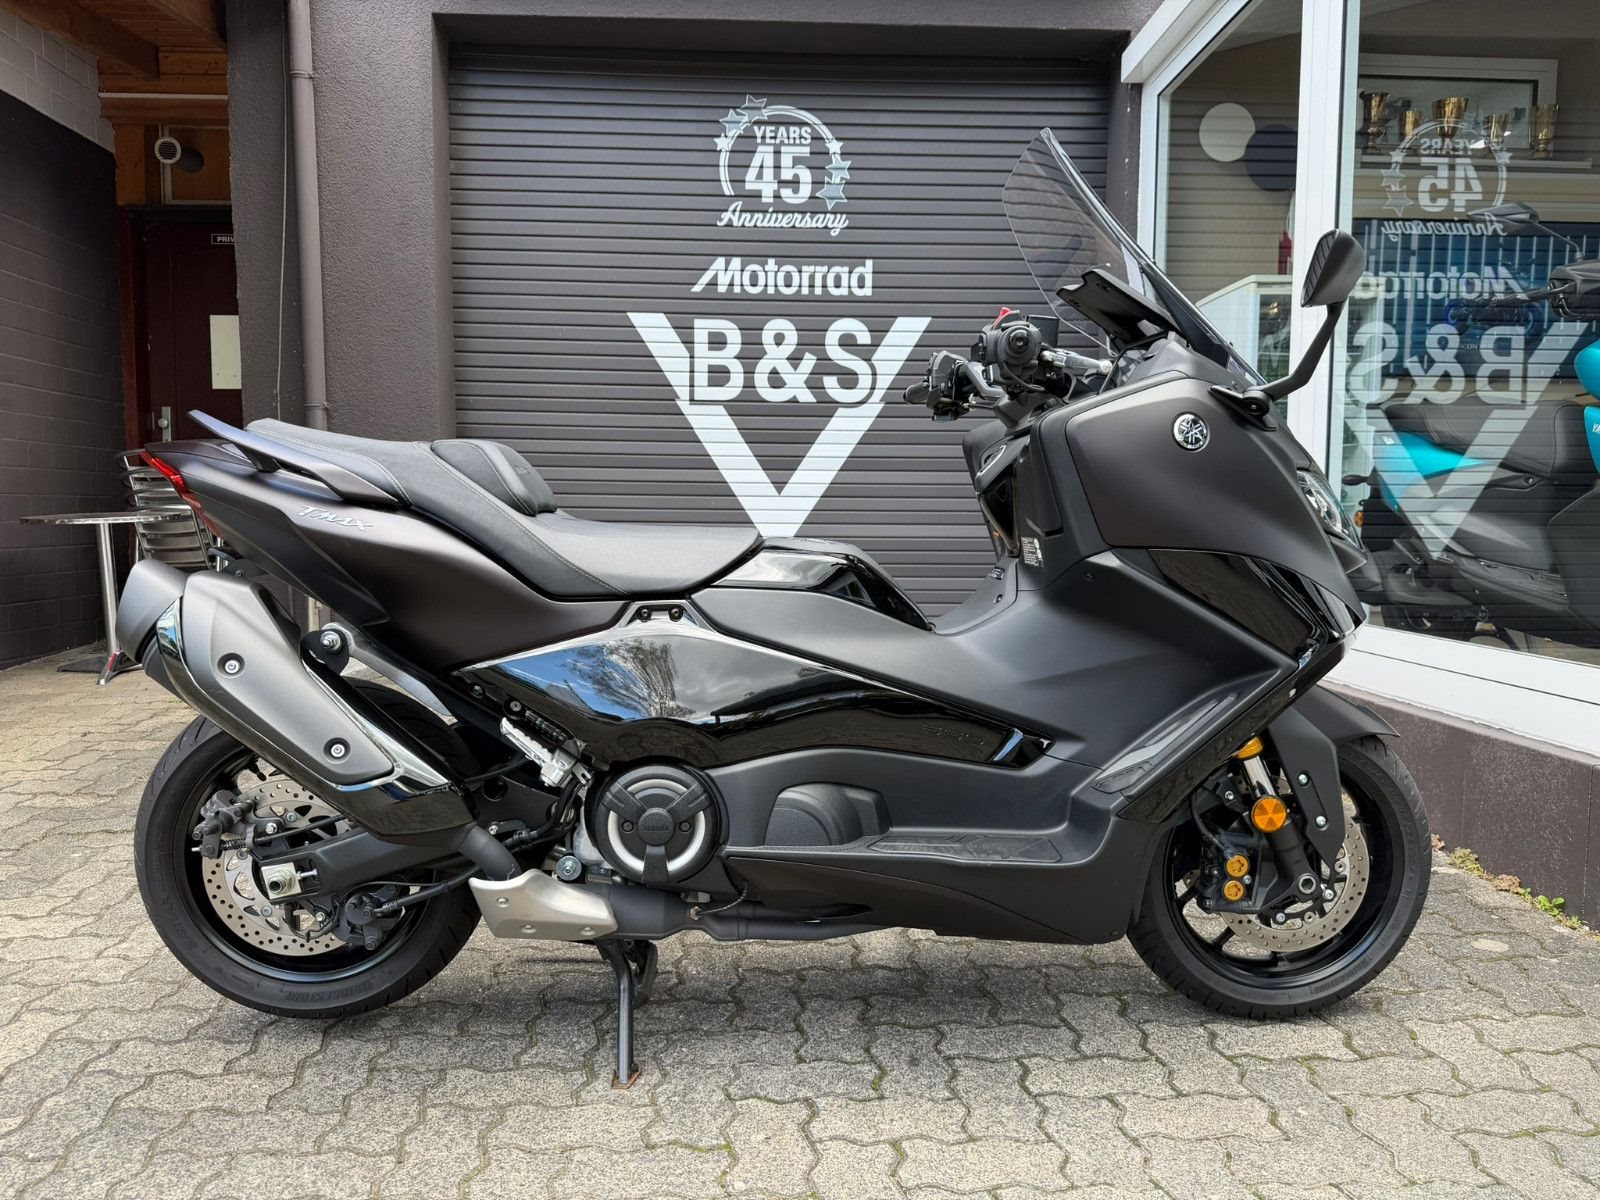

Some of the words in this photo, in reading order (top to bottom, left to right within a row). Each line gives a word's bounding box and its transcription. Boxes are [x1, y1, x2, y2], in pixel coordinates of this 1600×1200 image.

[753, 125, 812, 145] YEARS
[744, 145, 812, 204] 45
[716, 200, 849, 236] Anniversary
[690, 257, 873, 296] Motorrad
[693, 317, 874, 403] B&S
